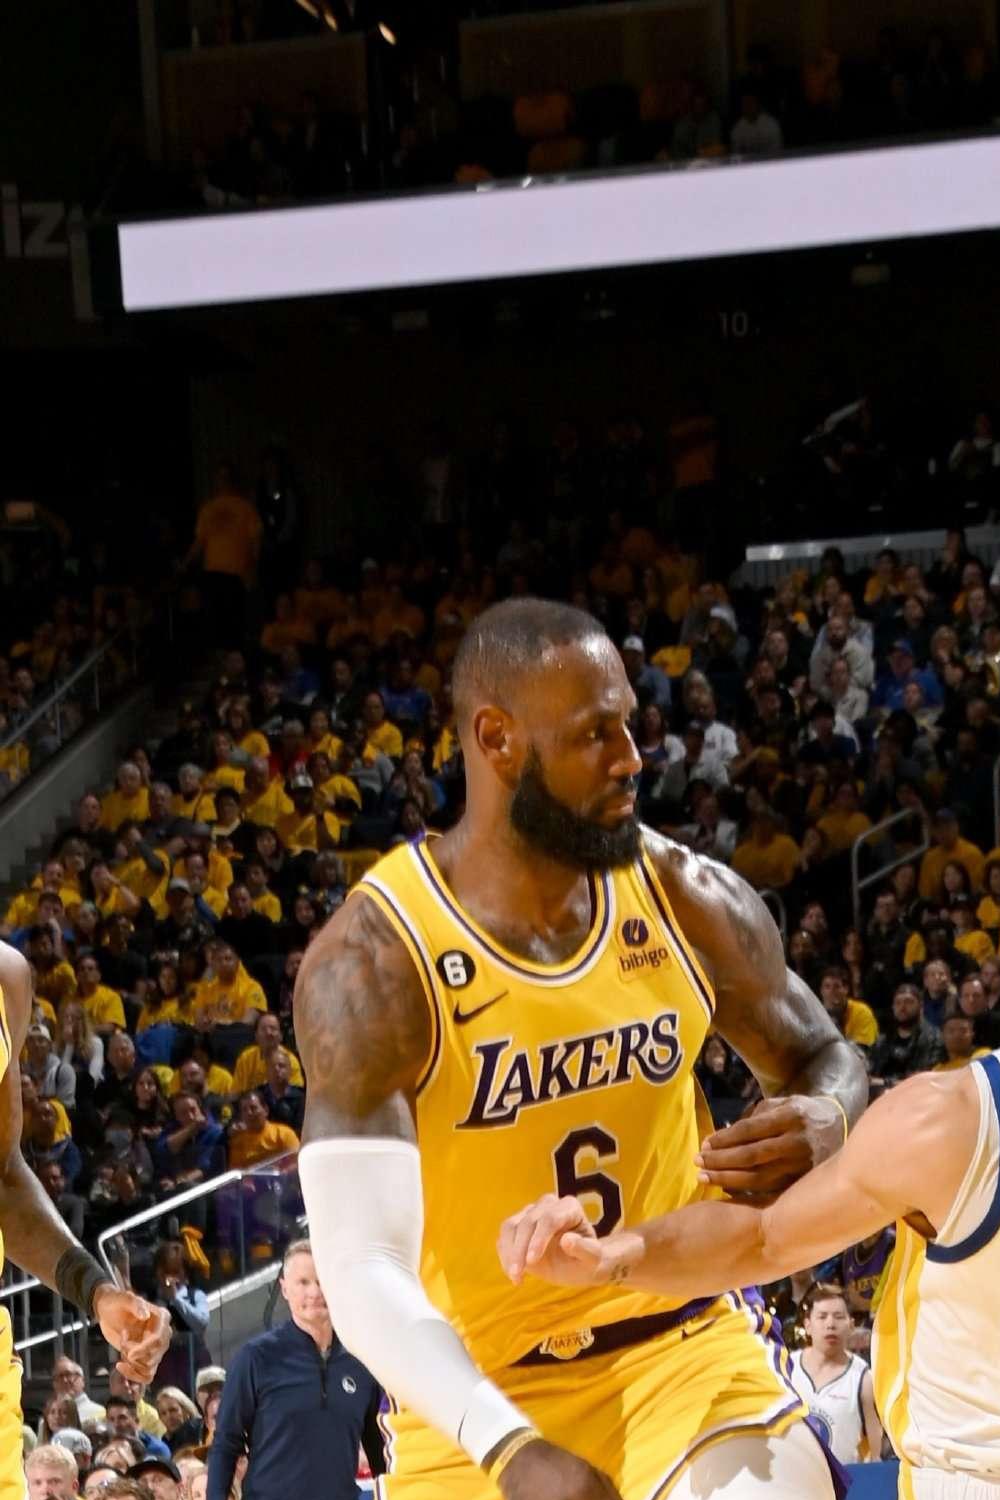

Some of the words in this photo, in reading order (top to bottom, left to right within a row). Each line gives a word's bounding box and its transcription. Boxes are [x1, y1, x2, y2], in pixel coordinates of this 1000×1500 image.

[443, 953, 468, 987] 6
[618, 946, 669, 972] bibigo
[454, 1010, 684, 1131] LAKERS
[554, 1121, 622, 1239] 6
